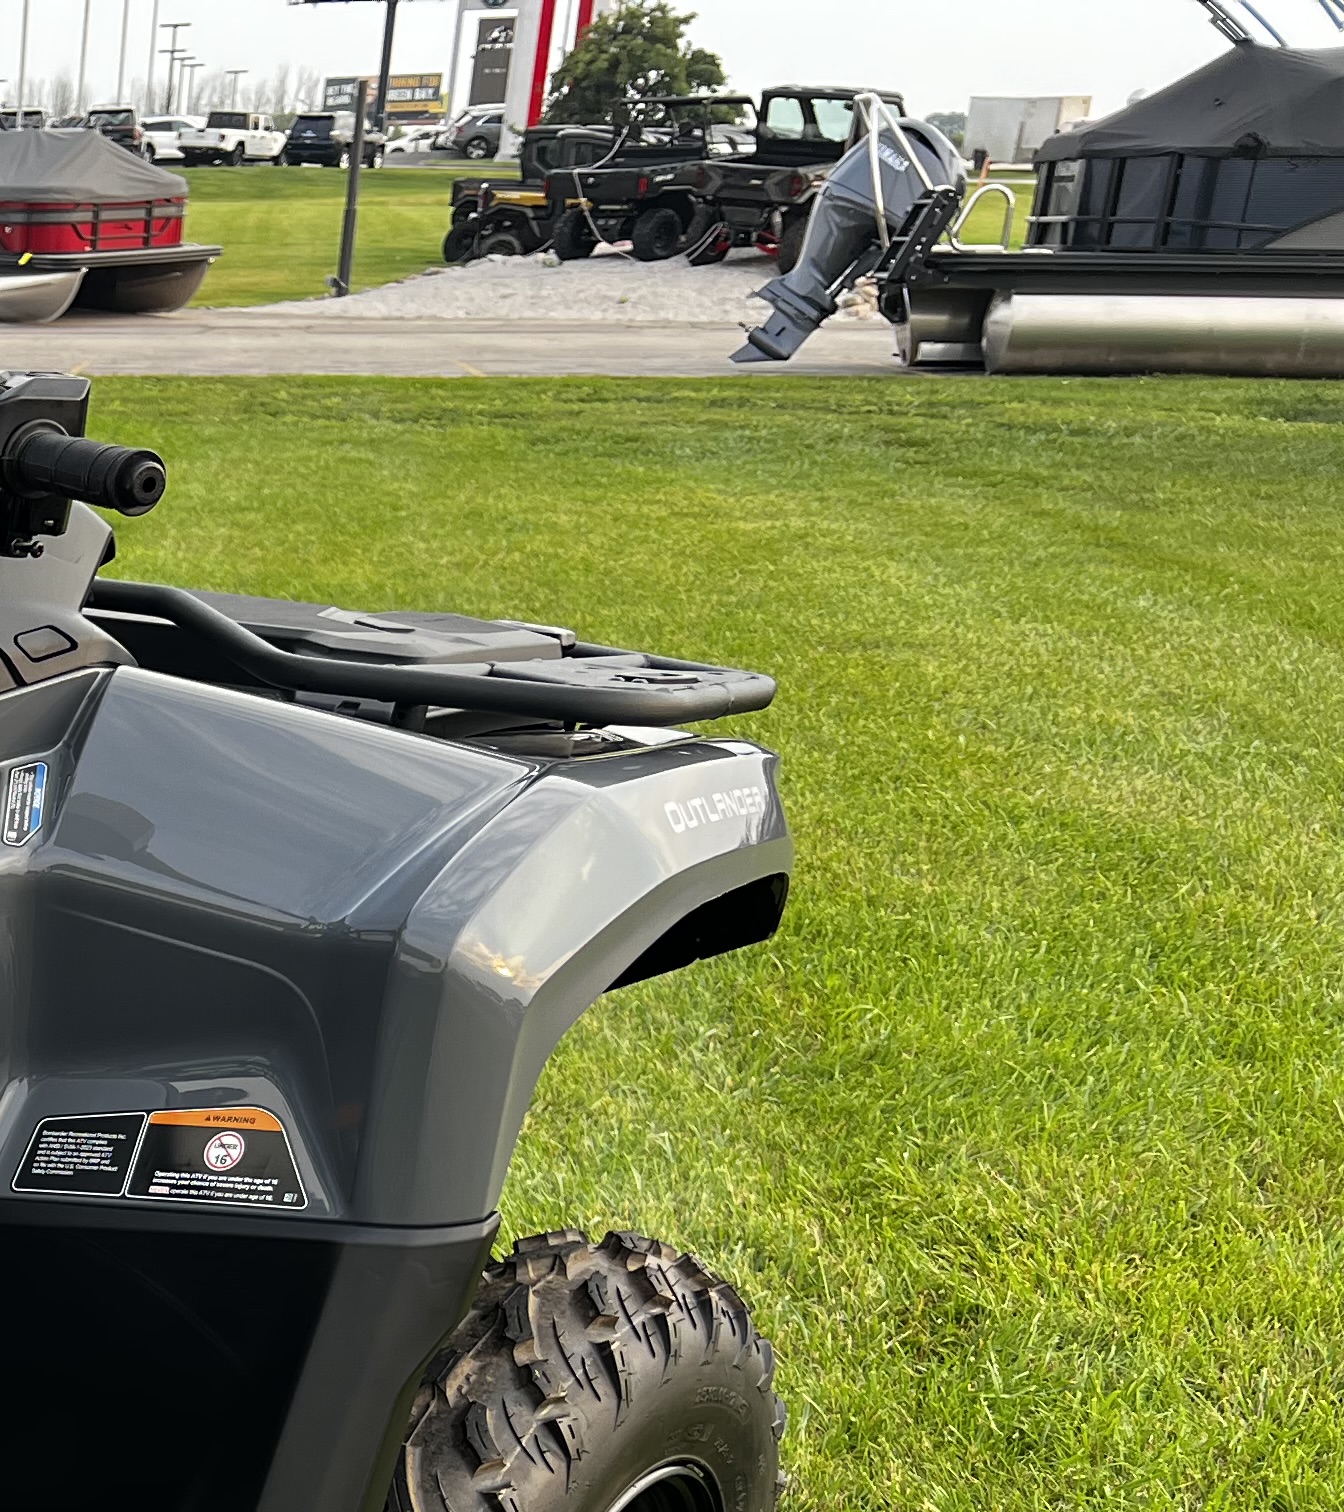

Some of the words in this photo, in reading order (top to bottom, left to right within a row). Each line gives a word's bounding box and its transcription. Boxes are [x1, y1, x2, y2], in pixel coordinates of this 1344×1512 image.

[664, 786, 763, 833] OUTLANDER
[212, 1115, 256, 1125] WARNING
[214, 1154, 228, 1165] 16
